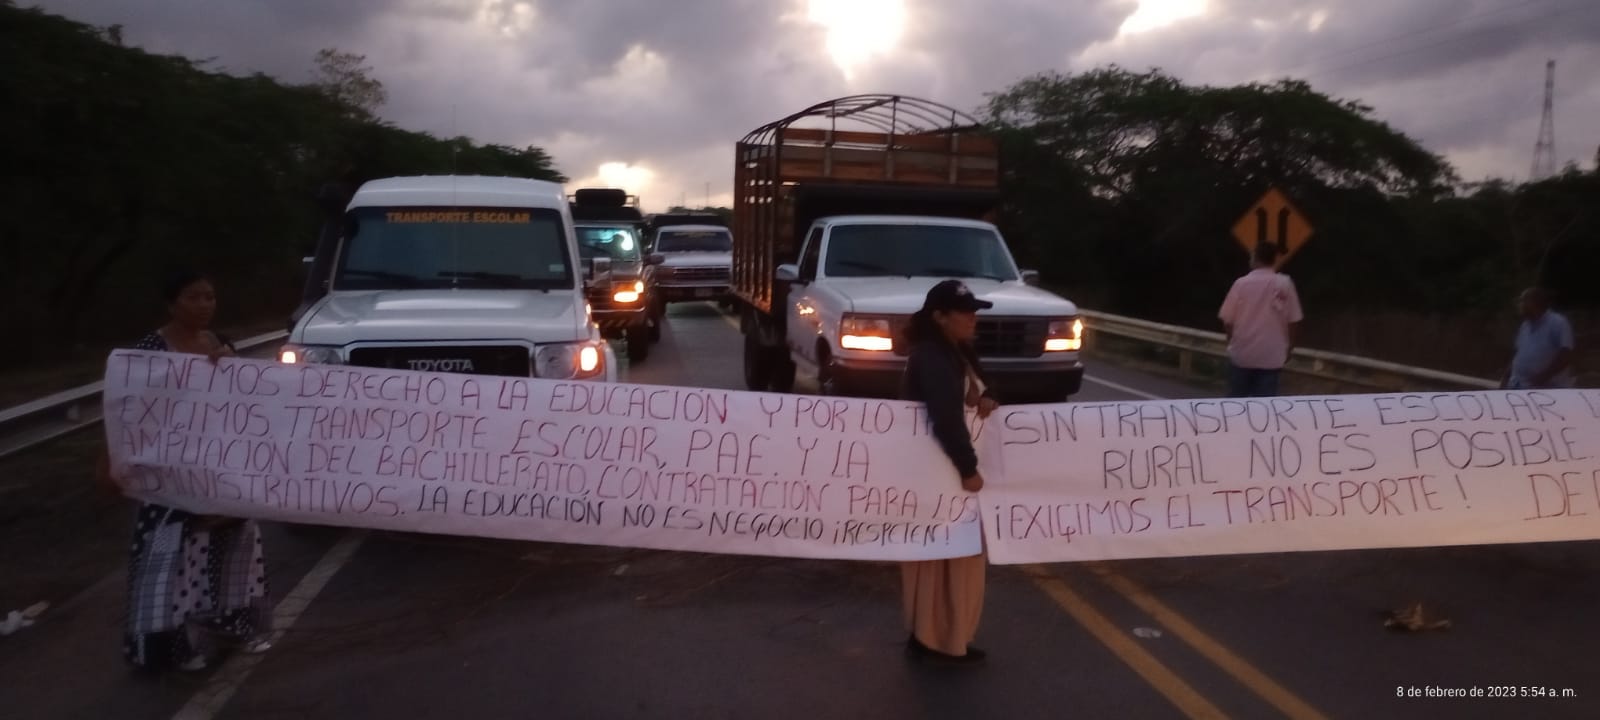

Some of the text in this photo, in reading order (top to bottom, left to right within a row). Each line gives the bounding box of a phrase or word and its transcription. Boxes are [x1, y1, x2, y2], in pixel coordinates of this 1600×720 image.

[385, 211, 531, 224] TRANSPORTE ESCOLAR
[115, 353, 281, 397] TENEMOS
[296, 366, 447, 406] DERECHO
[460, 378, 482, 410] A
[497, 379, 529, 411] LA
[759, 396, 784, 429] Y
[795, 397, 849, 433] POR
[860, 402, 894, 434] LO
[408, 359, 474, 371] TOYOTA
[284, 405, 490, 449] TRANSPORTE
[797, 436, 819, 476] Y
[831, 438, 870, 483] LA
[1003, 404, 1078, 445] SIN
[1083, 398, 1357, 439] TRANSPORTE
[1374, 391, 1565, 426] ESCOLAR
[304, 443, 363, 476] DEL
[848, 484, 918, 519] PARA
[931, 493, 979, 523] LOS
[1103, 441, 1218, 490] RURAL
[1249, 434, 1302, 480] NO
[1319, 432, 1377, 476] ES
[416, 484, 449, 514] LA
[622, 504, 656, 529] NO
[662, 505, 704, 532] ES
[707, 509, 825, 542] NEGOCIO
[1166, 493, 1206, 530] EL
[1211, 474, 1444, 525] TRANSPORTE
